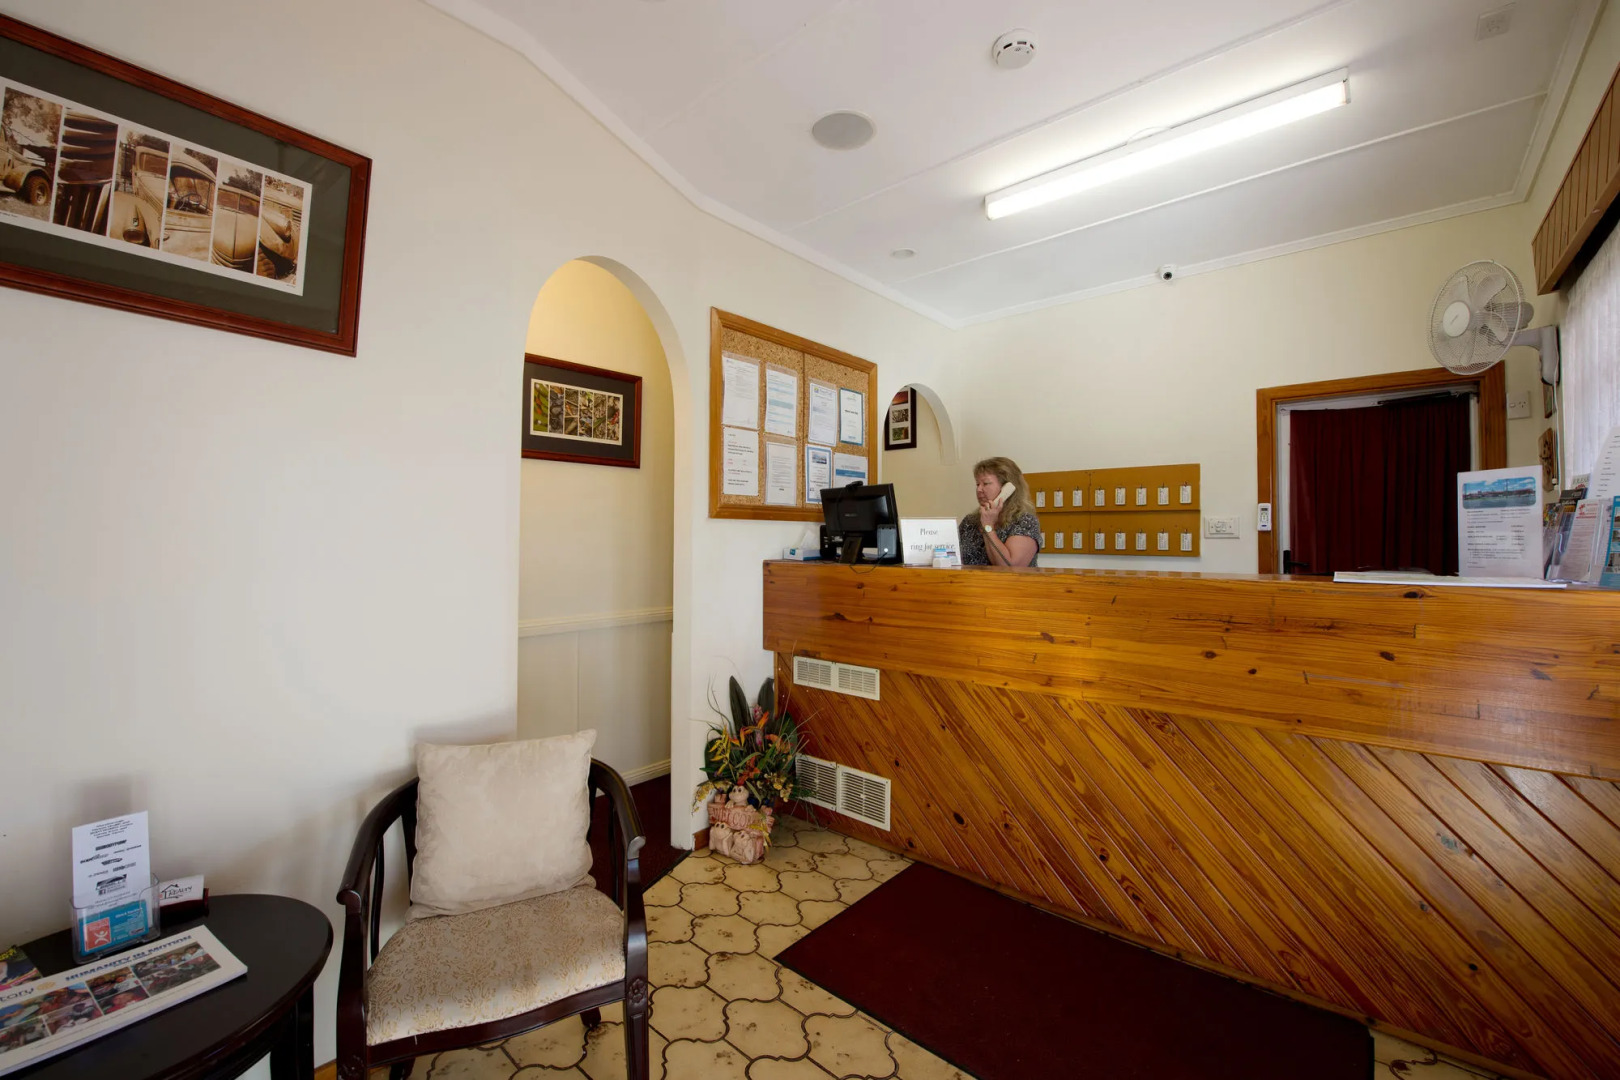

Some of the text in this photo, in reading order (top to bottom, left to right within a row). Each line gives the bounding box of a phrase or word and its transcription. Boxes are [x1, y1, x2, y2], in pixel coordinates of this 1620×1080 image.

[910, 542, 923, 551] ring
[924, 542, 933, 551] for
[713, 807, 758, 828] WELCOM
[66, 956, 130, 981] HUMANITY
